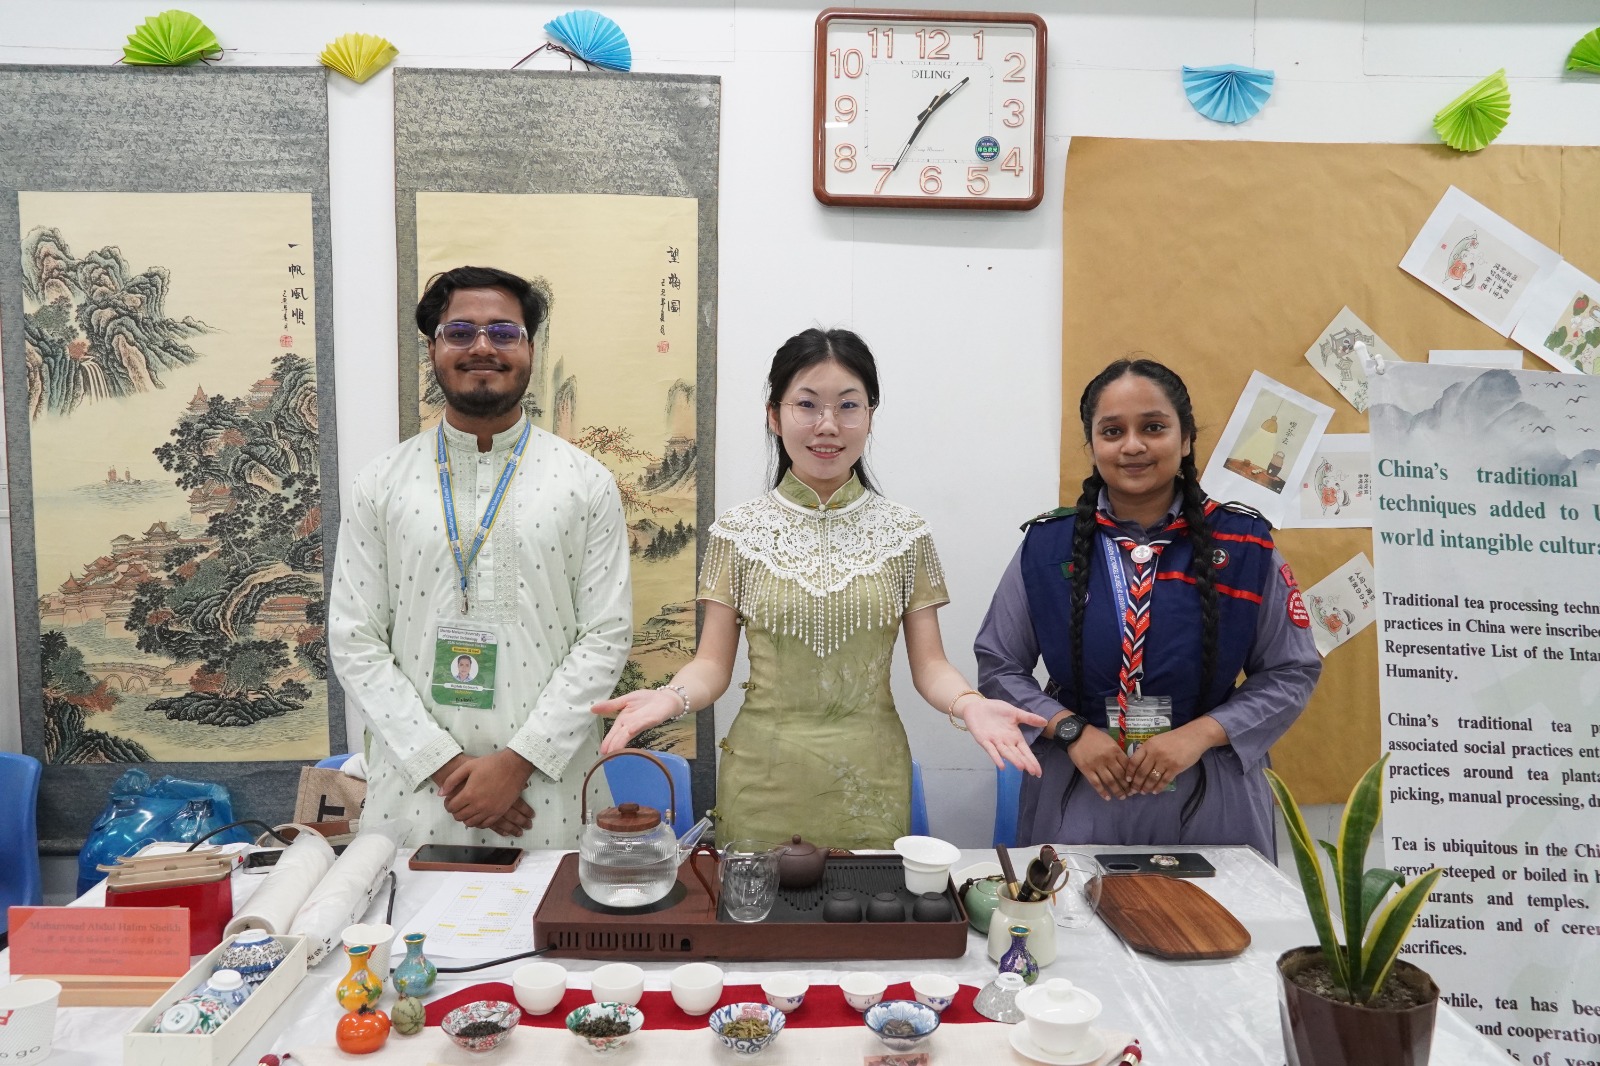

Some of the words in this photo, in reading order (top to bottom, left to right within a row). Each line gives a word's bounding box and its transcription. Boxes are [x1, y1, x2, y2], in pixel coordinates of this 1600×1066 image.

[868, 28, 894, 58] 11
[916, 29, 950, 60] 12
[973, 30, 984, 60] 1
[830, 48, 863, 78] 10
[1003, 52, 1026, 82] 2
[835, 95, 857, 124] 9
[1003, 99, 1024, 128] 3
[834, 143, 857, 172] 8
[1001, 147, 1023, 176] 4
[872, 164, 894, 194] 7
[920, 166, 942, 194] 6
[967, 167, 989, 195] 5
[1477, 467, 1578, 487] traditional
[1379, 494, 1476, 518] techniques
[1490, 500, 1546, 519] added
[1560, 504, 1578, 520] to
[1381, 528, 1434, 547] world
[1440, 530, 1533, 555] intangible
[1383, 592, 1458, 608] Traditional
[1464, 597, 1484, 609] tea
[1490, 598, 1558, 616] processing
[1564, 601, 1600, 614] techn
[1384, 617, 1443, 632] practices
[1448, 619, 1460, 632] in
[1466, 619, 1505, 634] China
[1511, 624, 1541, 636] were
[1546, 623, 1600, 637] inscribe
[1385, 640, 1486, 657] Representative
[1492, 644, 1517, 658] List
[1524, 646, 1538, 659] of
[1544, 647, 1564, 660] the
[1570, 648, 1600, 661] Inta
[1386, 664, 1458, 682] Humanity.
[1458, 716, 1532, 731] traditional
[1551, 720, 1572, 732] tea
[1591, 724, 1600, 737] p
[1388, 738, 1458, 753] associated
[1464, 741, 1505, 754] social
[1512, 743, 1573, 758] practices
[1389, 763, 1450, 778] practices
[1464, 766, 1513, 779] around
[1527, 768, 1549, 780] tea
[1390, 787, 1444, 804] picking,
[1448, 791, 1501, 804] manual
[1506, 793, 1584, 810] processing,
[1392, 837, 1417, 850] Tea
[1424, 838, 1436, 851] is
[1443, 839, 1517, 856] ubiquitous
[1525, 842, 1538, 856] in
[1546, 843, 1567, 857] the
[1442, 866, 1495, 882] steeped
[1502, 870, 1516, 880] or
[1524, 868, 1566, 882] boiled
[1574, 869, 1588, 883] in
[1426, 891, 1473, 904] urants
[1487, 892, 1513, 906] and
[1527, 894, 1589, 911] temples.
[1497, 918, 1522, 932] and
[1534, 919, 1550, 932] of
[1400, 940, 1467, 956] sacrifices.
[1495, 996, 1518, 1010] tea
[1530, 996, 1558, 1012] has
[1507, 1026, 1600, 1044] cooperatio
[1533, 1052, 1551, 1066] of
